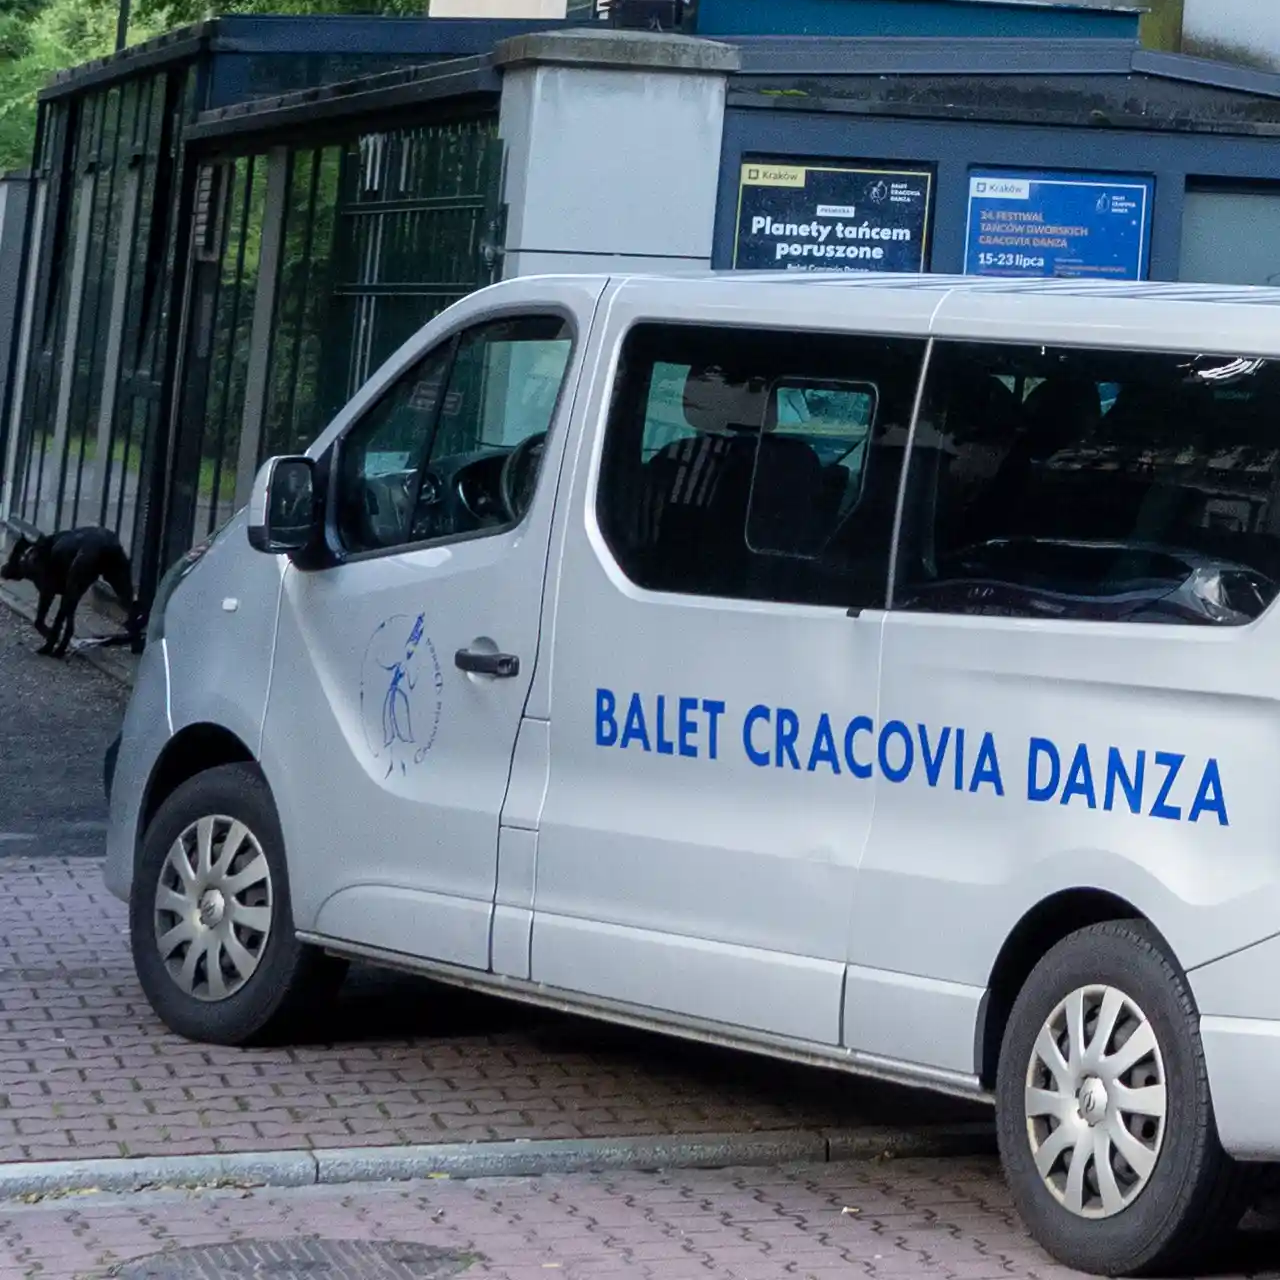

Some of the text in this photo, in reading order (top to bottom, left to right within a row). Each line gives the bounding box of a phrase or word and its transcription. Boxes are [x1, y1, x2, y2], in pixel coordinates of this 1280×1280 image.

[762, 171, 798, 181] Kraków
[996, 211, 1044, 222] FESTIWAL
[752, 216, 911, 241] Planety tańcem
[775, 243, 884, 259] poruszone
[978, 252, 1014, 265] 15-23
[1015, 254, 1045, 268] lipca
[594, 688, 1230, 827] BALET CRACOVIA DANZA
